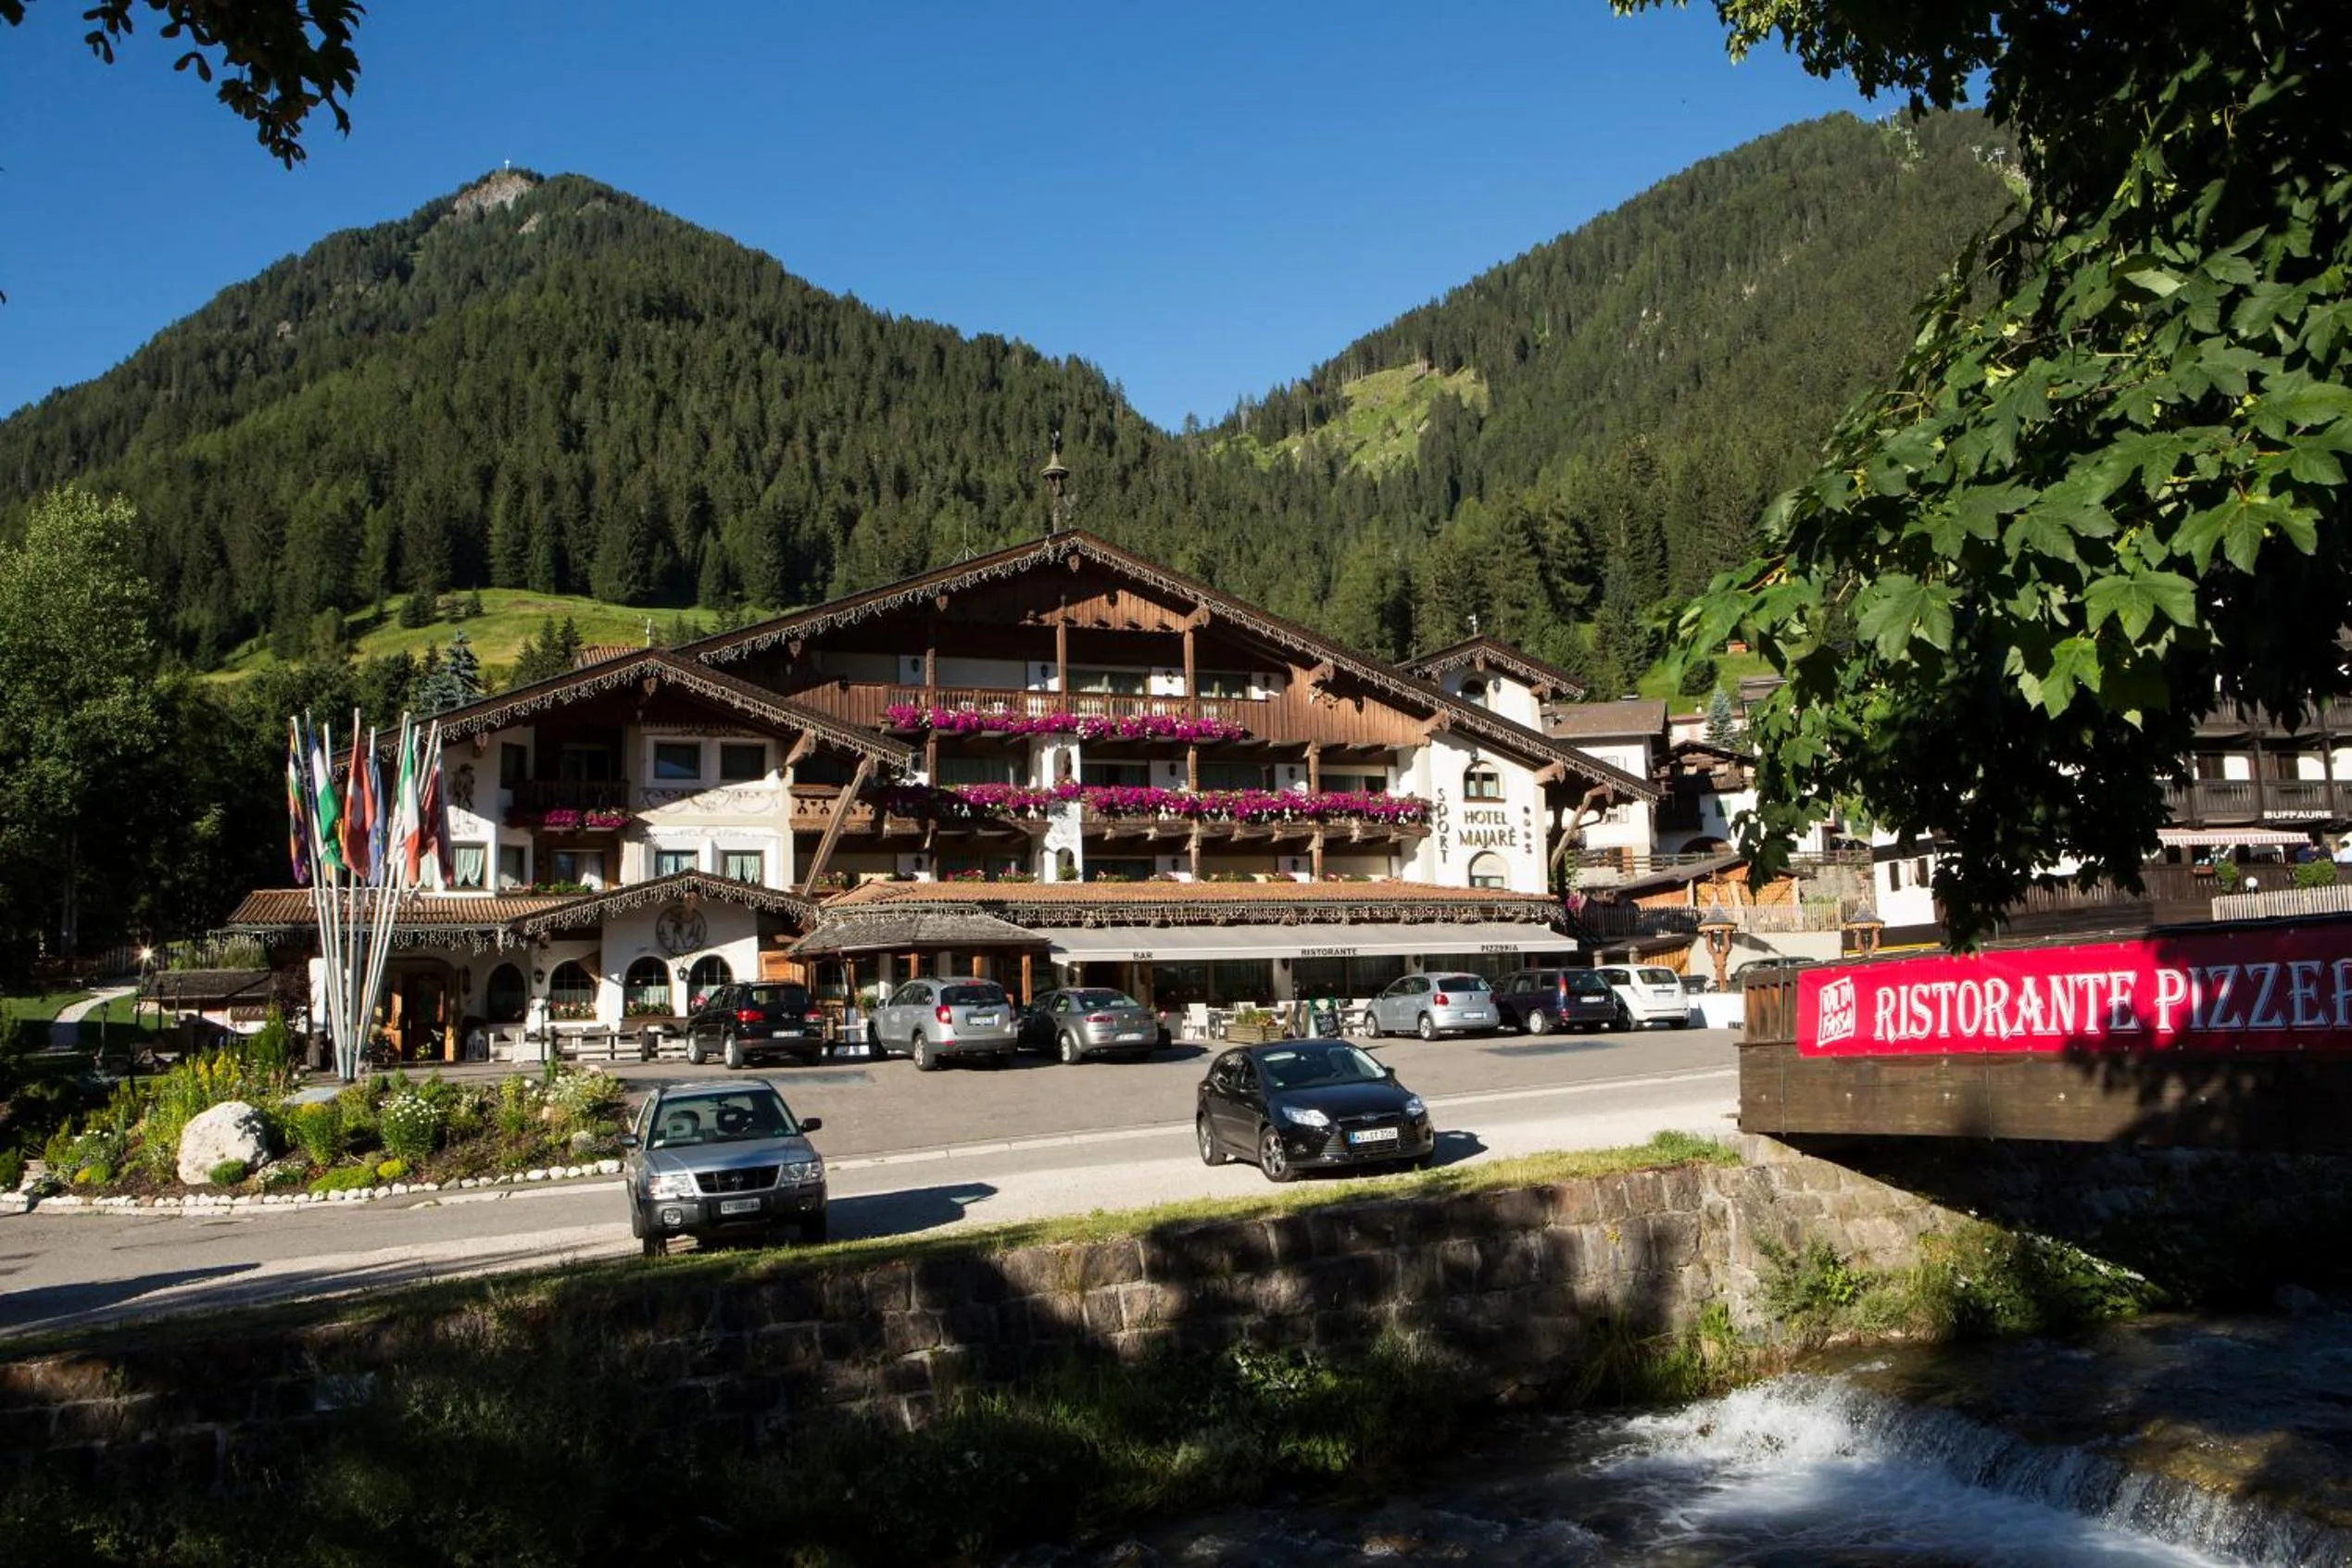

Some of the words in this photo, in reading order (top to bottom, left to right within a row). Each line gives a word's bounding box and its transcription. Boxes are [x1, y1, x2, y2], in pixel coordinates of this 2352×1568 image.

[1464, 809, 1508, 824] HOTEL
[2263, 809, 2333, 820] BUFFAURE
[1437, 787, 1450, 864] SPORT
[1301, 947, 1357, 956] RISTORANTE
[1480, 944, 1519, 953] PIZZERIA
[1133, 951, 1153, 960] BAR
[1873, 970, 2142, 1044] RISTORANTE
